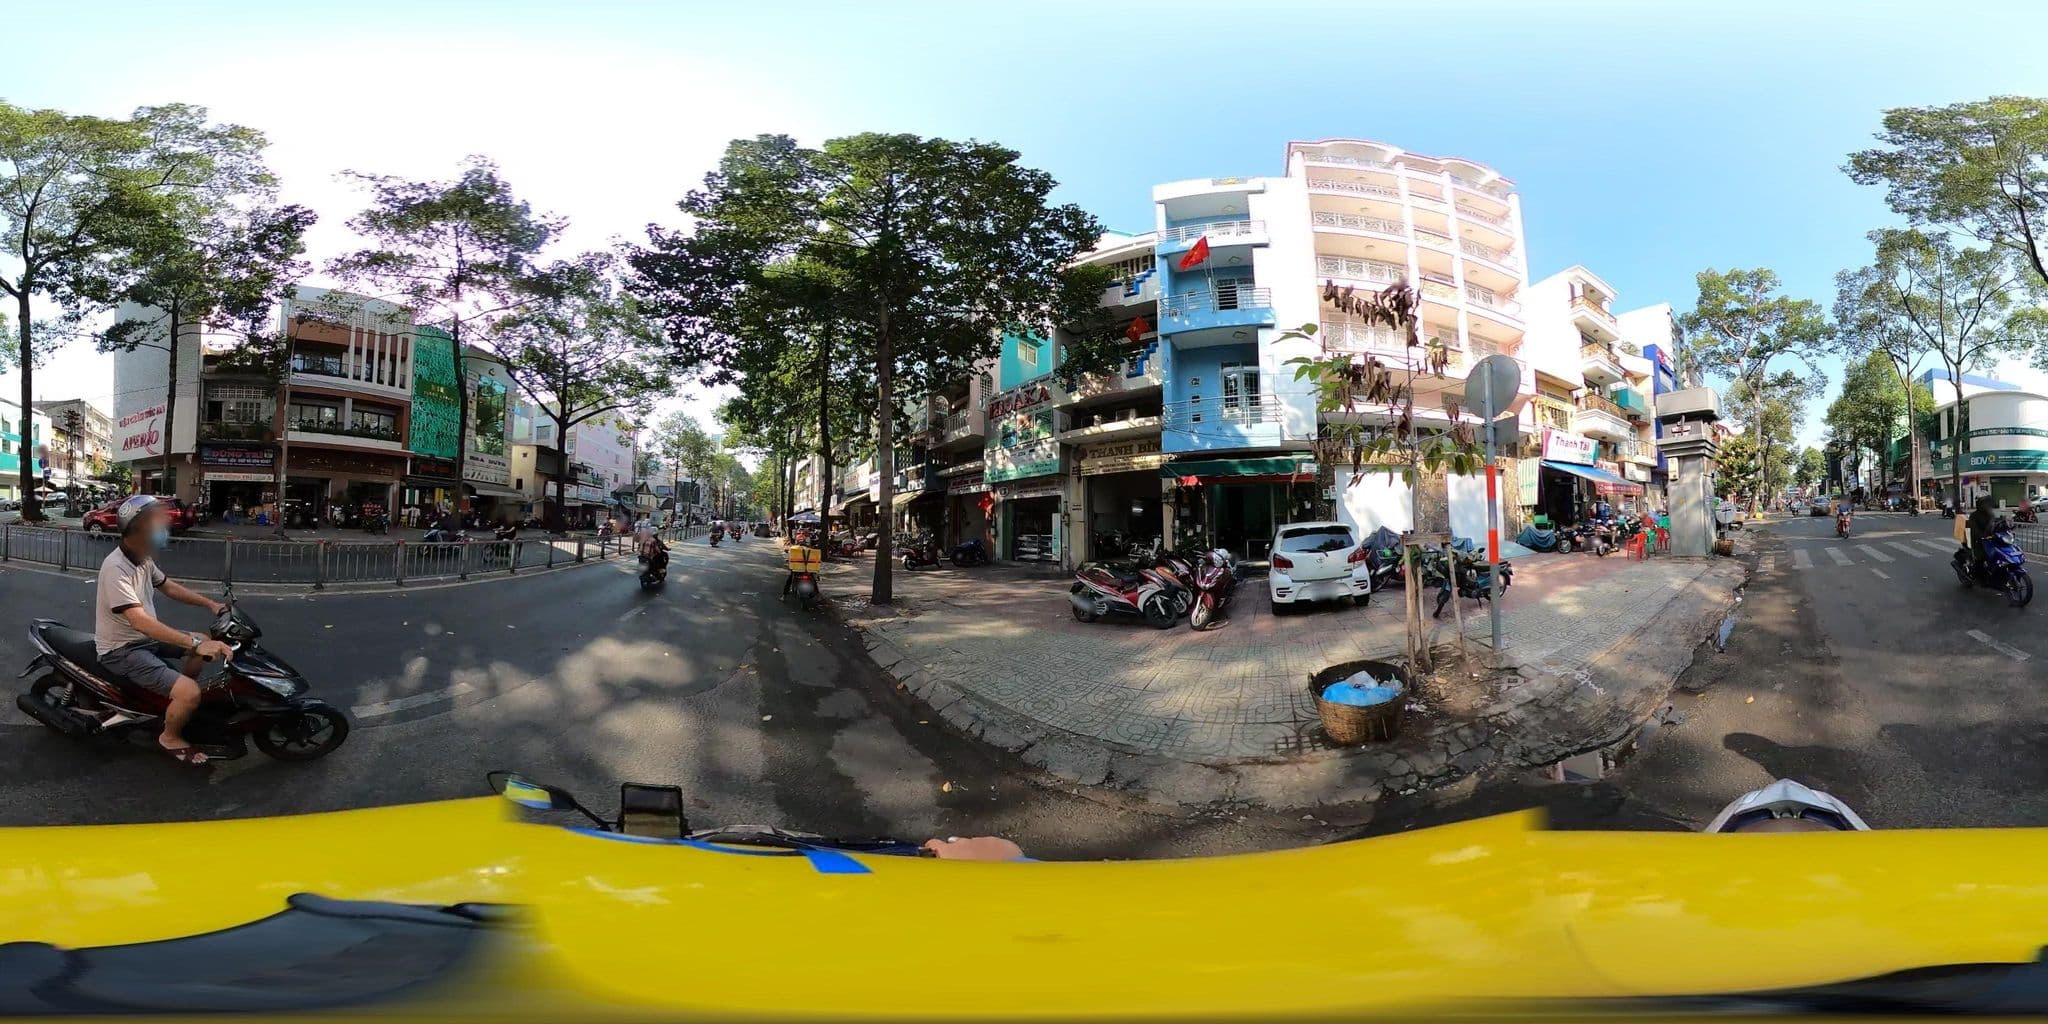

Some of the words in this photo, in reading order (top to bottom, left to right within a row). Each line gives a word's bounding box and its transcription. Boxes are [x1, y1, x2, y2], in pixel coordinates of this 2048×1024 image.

[1555, 436, 1578, 449] Thanh
[1089, 444, 1134, 459] THANH
[1970, 456, 1988, 466] BIDV
